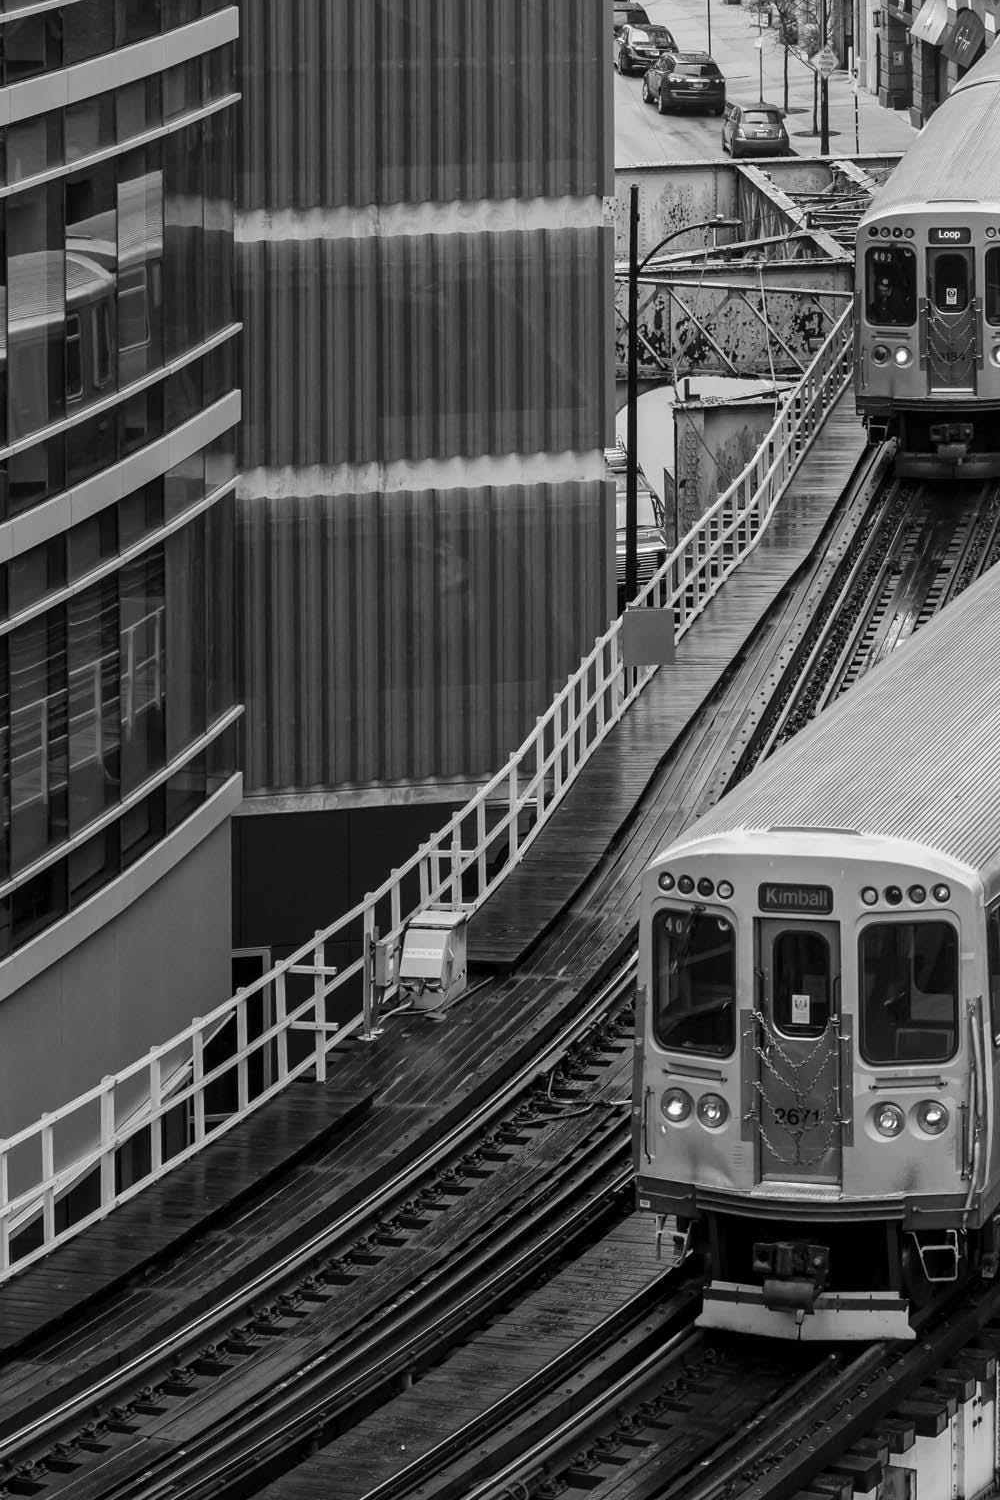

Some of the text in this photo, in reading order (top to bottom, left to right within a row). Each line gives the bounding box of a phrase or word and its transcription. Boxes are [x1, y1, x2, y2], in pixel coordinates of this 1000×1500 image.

[938, 229, 961, 240] Loop
[873, 251, 892, 262] 402
[766, 888, 828, 907] Kimball
[774, 1108, 819, 1126] 2671
